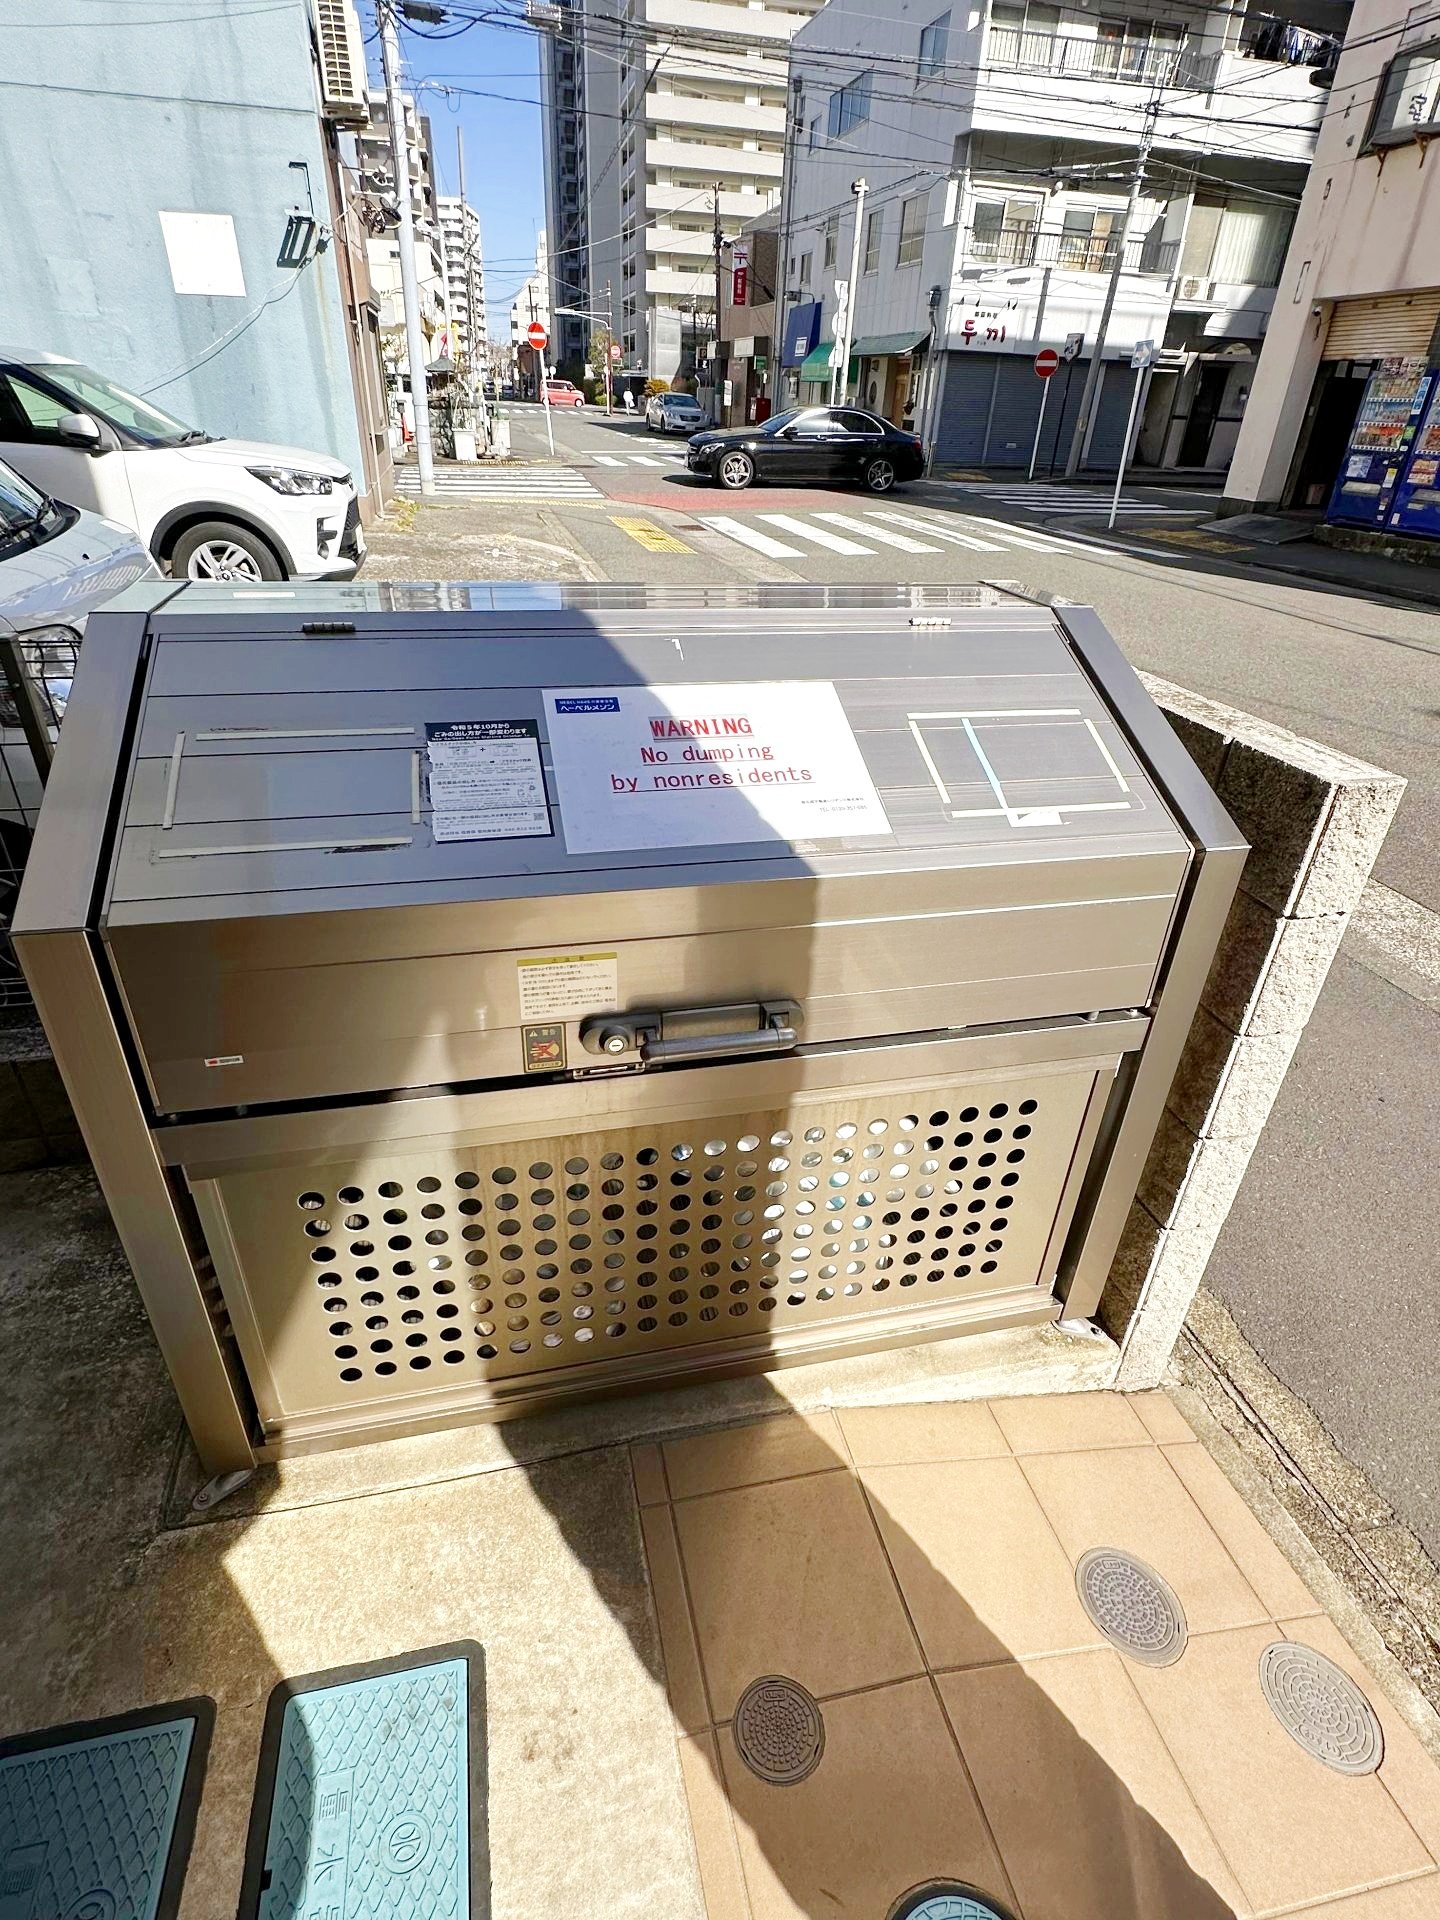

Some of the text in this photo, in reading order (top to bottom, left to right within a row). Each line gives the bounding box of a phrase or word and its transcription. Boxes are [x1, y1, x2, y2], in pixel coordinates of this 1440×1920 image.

[434, 728, 527, 738] ごみの出し方が一部変わります
[649, 717, 753, 737] WARNING
[640, 744, 774, 763] No dumping
[611, 767, 812, 792] by nonresidents
